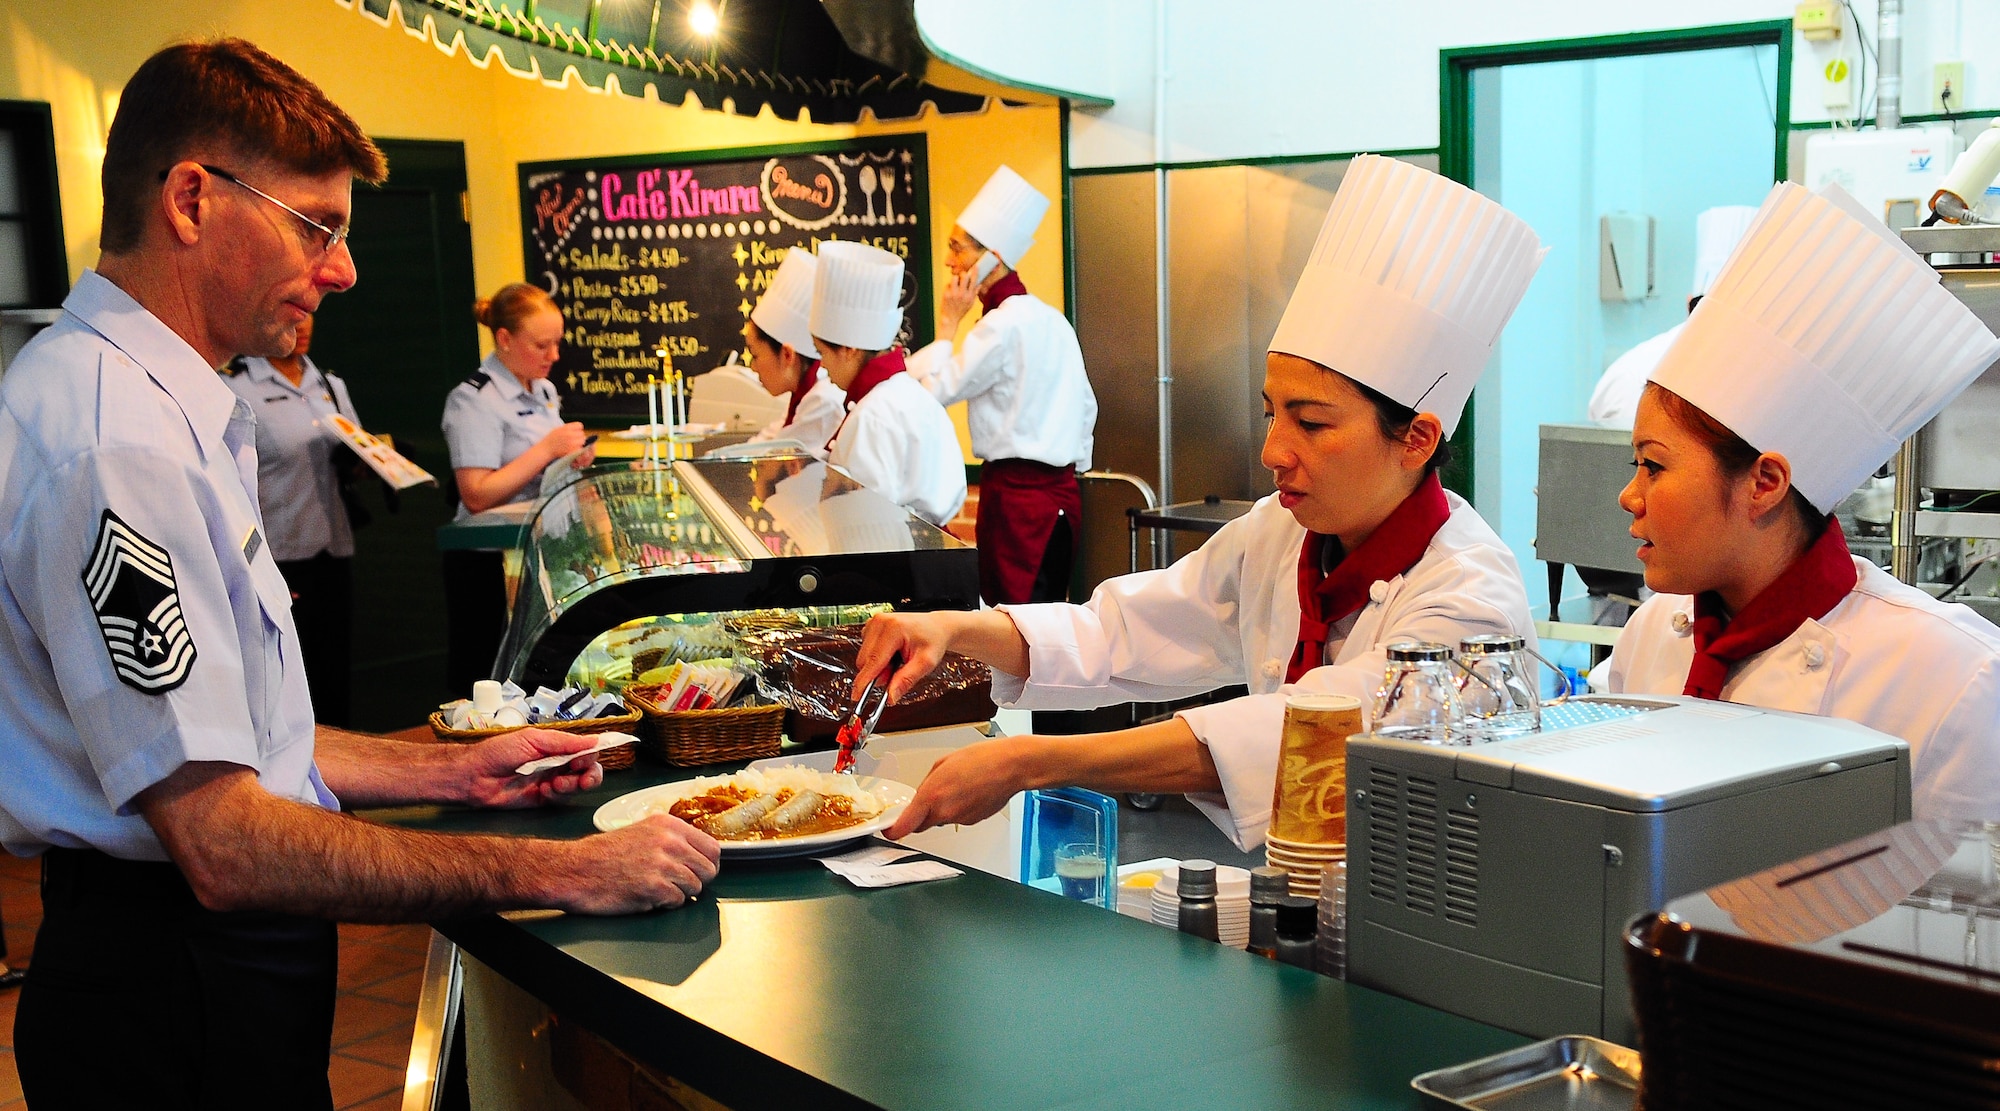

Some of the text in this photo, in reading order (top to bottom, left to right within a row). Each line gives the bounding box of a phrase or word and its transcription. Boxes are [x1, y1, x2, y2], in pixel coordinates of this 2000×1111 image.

[601, 168, 762, 222] Café Kirara
[569, 242, 630, 272] Salads
[572, 276, 612, 299] Pasta
